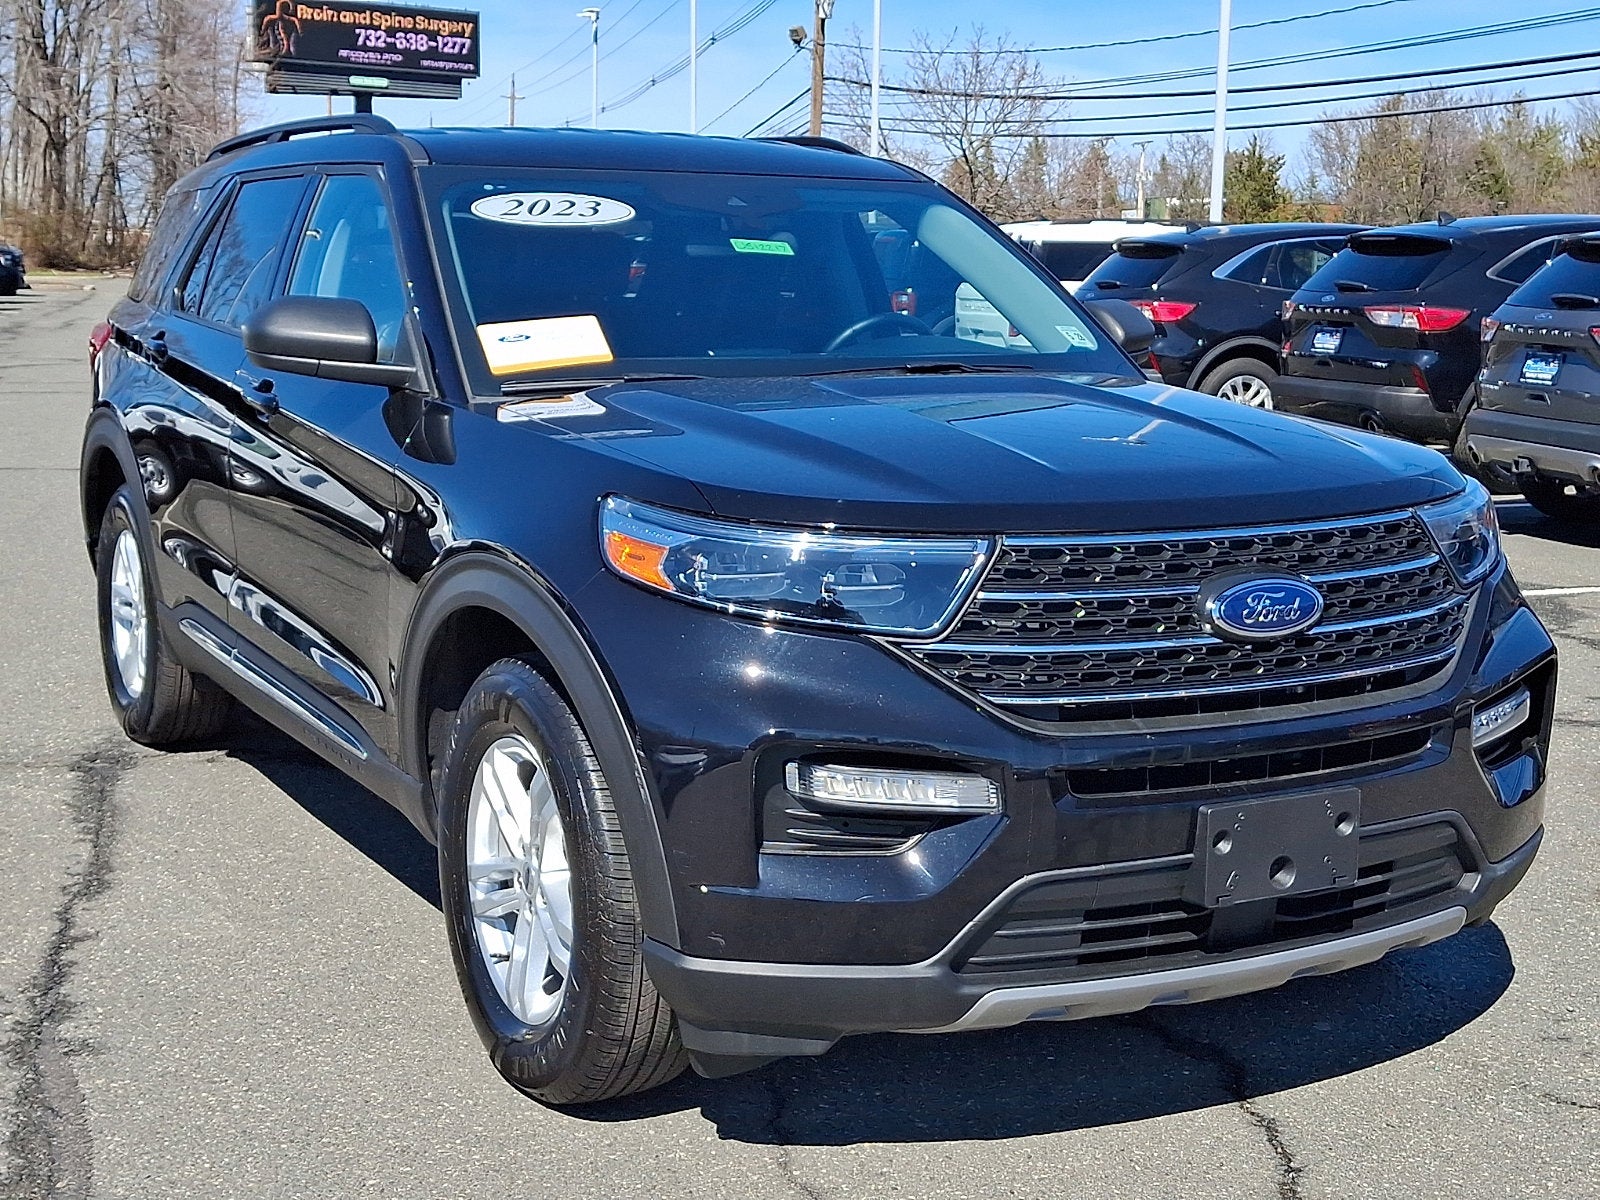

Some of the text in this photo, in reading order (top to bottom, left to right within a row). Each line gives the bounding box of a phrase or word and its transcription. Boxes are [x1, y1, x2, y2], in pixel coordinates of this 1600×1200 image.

[340, 10, 371, 25] and
[372, 11, 414, 30] Spine
[415, 15, 474, 37] Surgery
[499, 198, 602, 217] 2023
[1242, 591, 1301, 624] Ford
